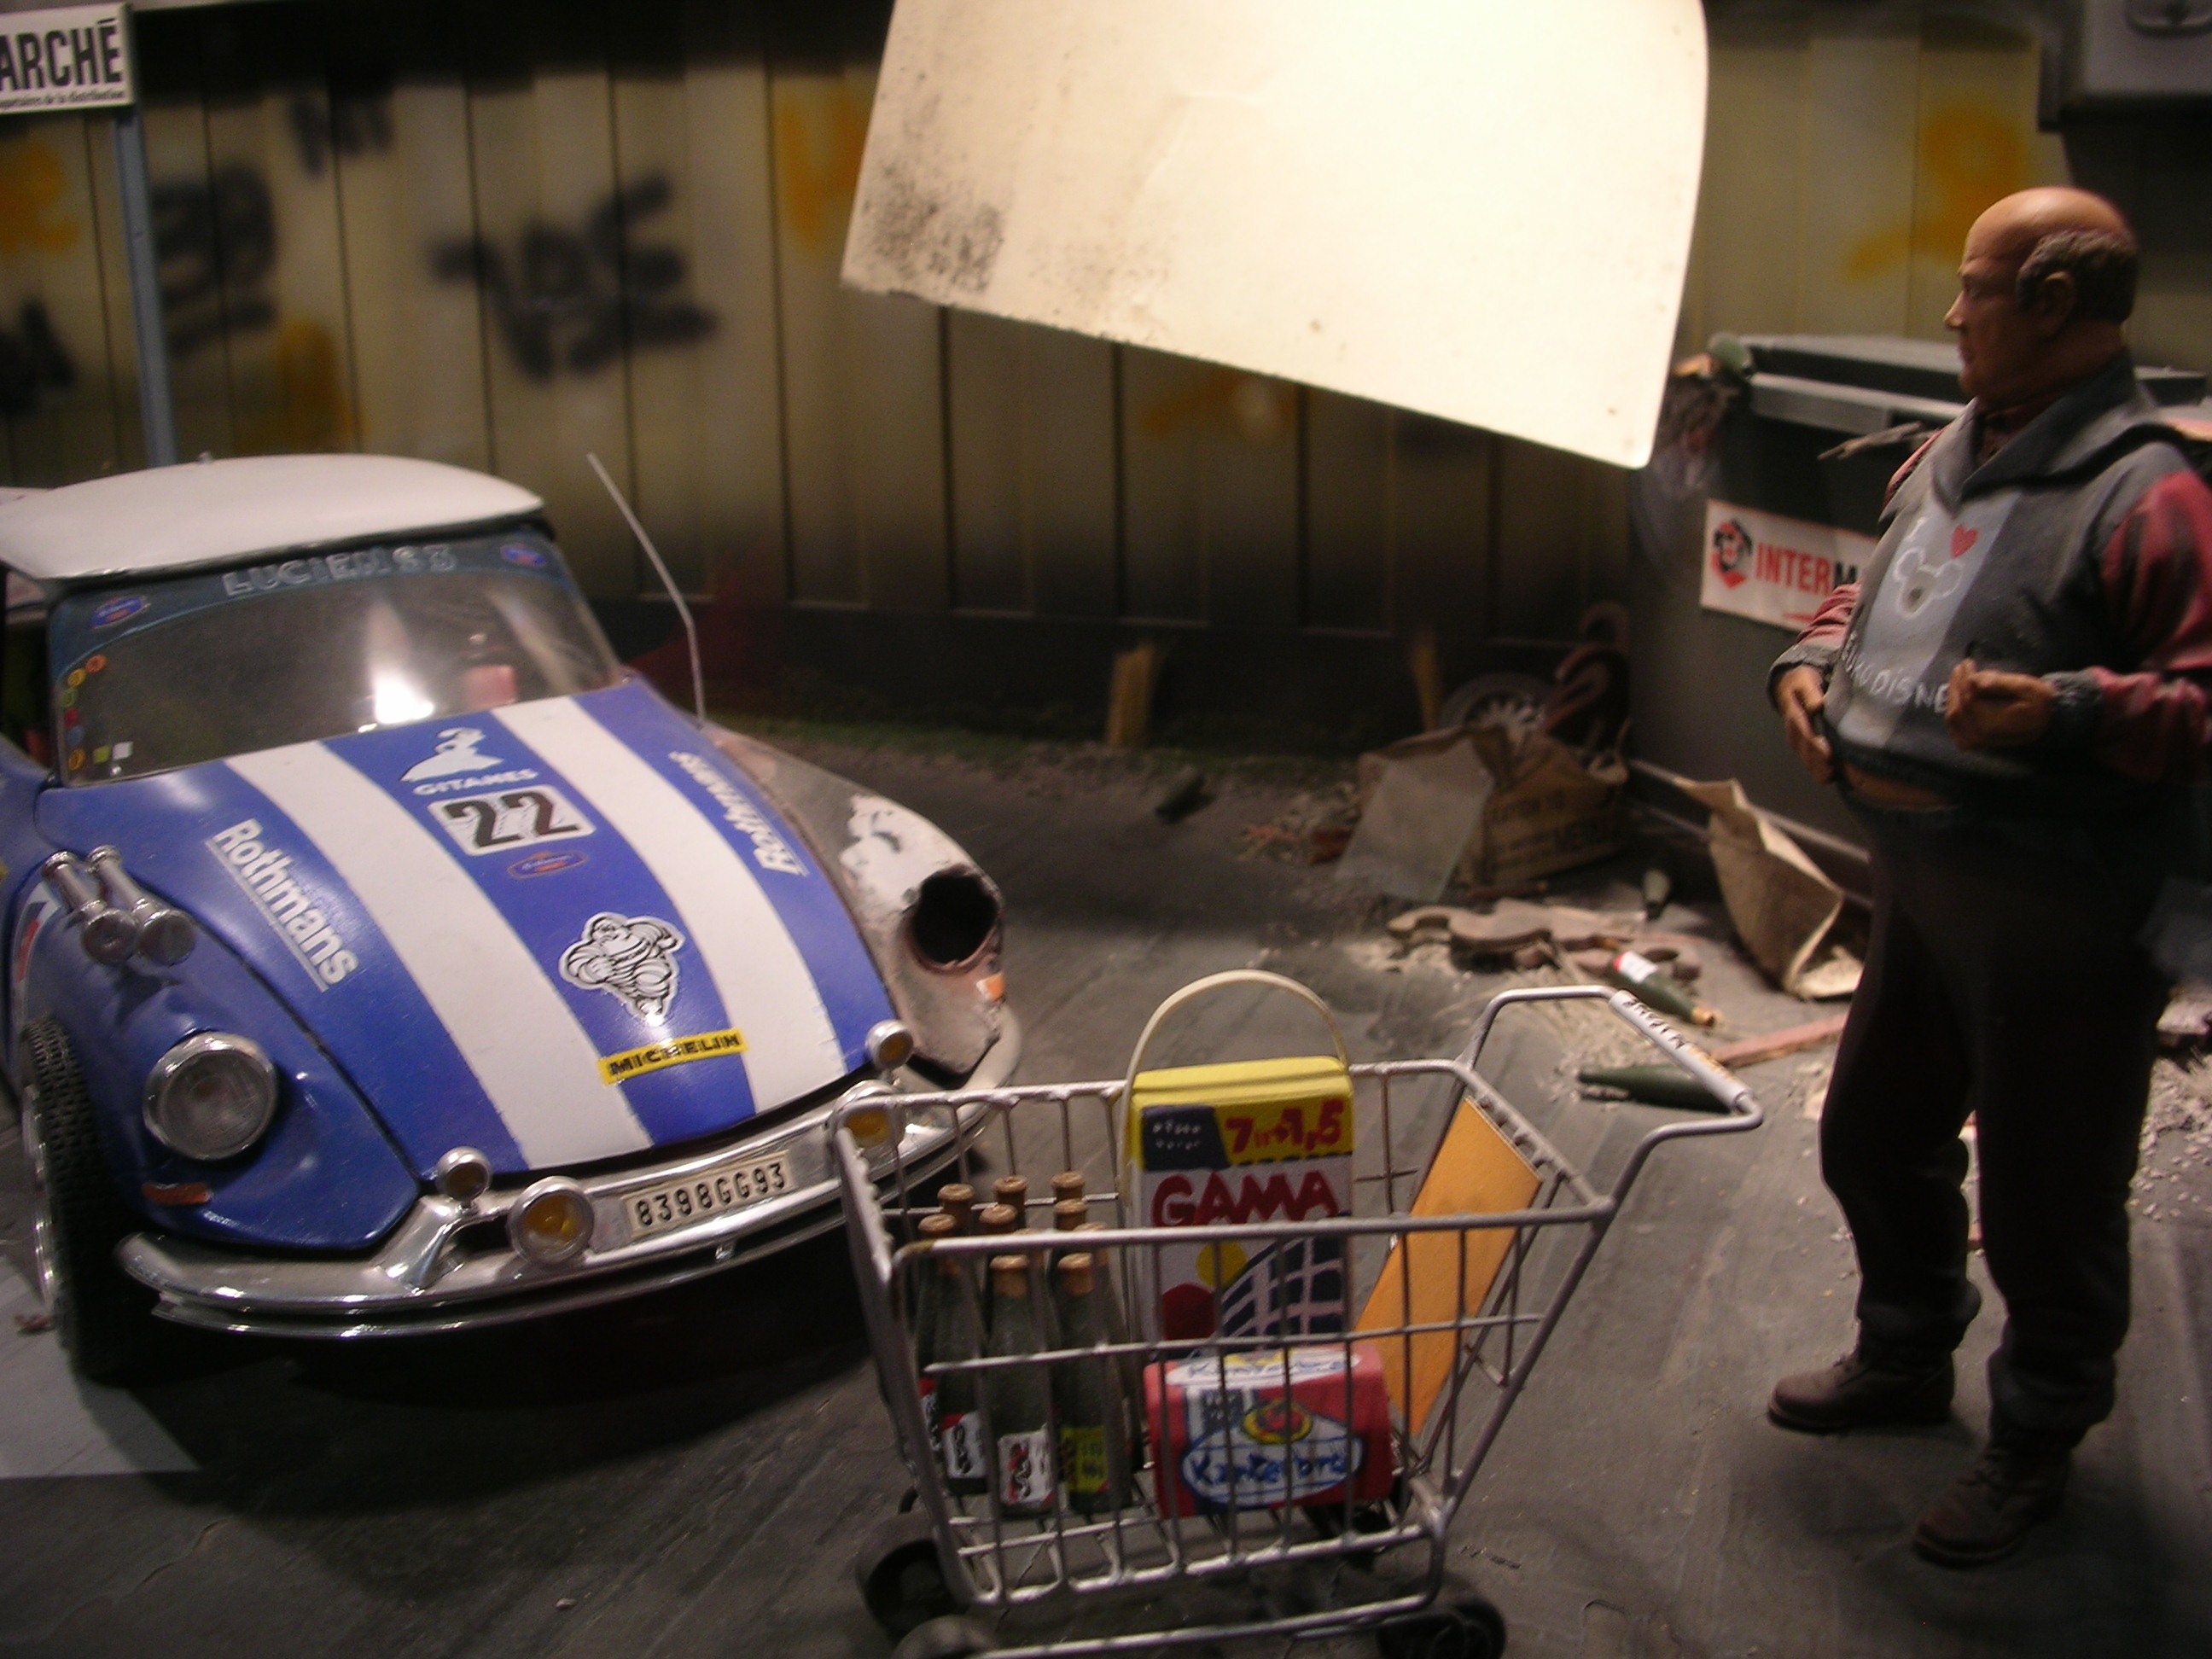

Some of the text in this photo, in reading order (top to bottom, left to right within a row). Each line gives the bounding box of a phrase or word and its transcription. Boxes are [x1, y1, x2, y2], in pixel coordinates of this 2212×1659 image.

[0, 17, 122, 90] ARCHÉ
[412, 768, 538, 795] GITANES
[443, 791, 579, 847] 22
[668, 750, 806, 876] Rothmans
[209, 818, 359, 987] Rothmans
[608, 1033, 741, 1076] MICHELIN
[635, 1161, 786, 1226] 8398GG93
[1154, 1170, 1339, 1227] GAMA
